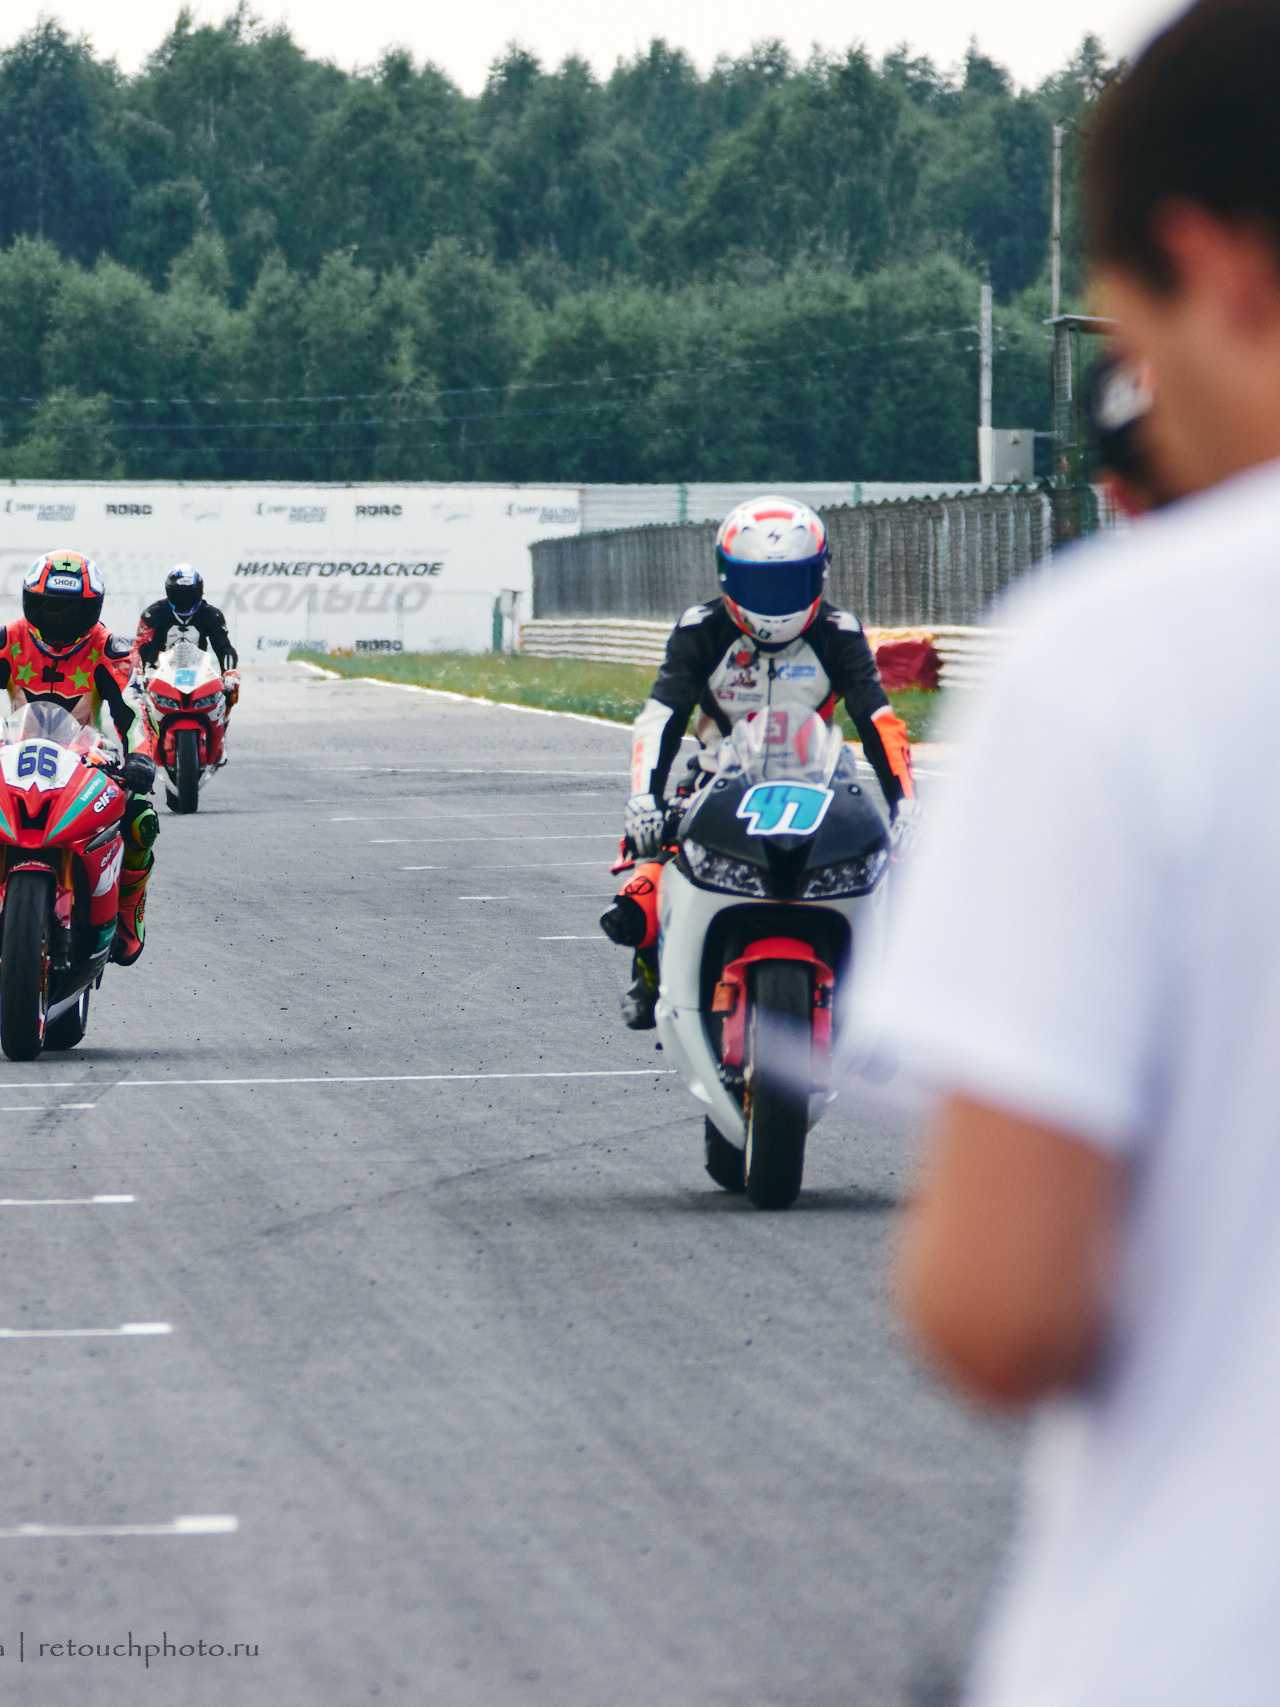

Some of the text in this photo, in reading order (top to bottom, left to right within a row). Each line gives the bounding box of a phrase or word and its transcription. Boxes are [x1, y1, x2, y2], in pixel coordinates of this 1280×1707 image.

[235, 562, 444, 577] НИЖЕГОРОДСКОЕ
[53, 577, 77, 588] SHOEI
[221, 582, 433, 614] КОЛЬЦО
[174, 669, 196, 686] 21
[18, 745, 59, 780] 66
[93, 795, 110, 814] elf
